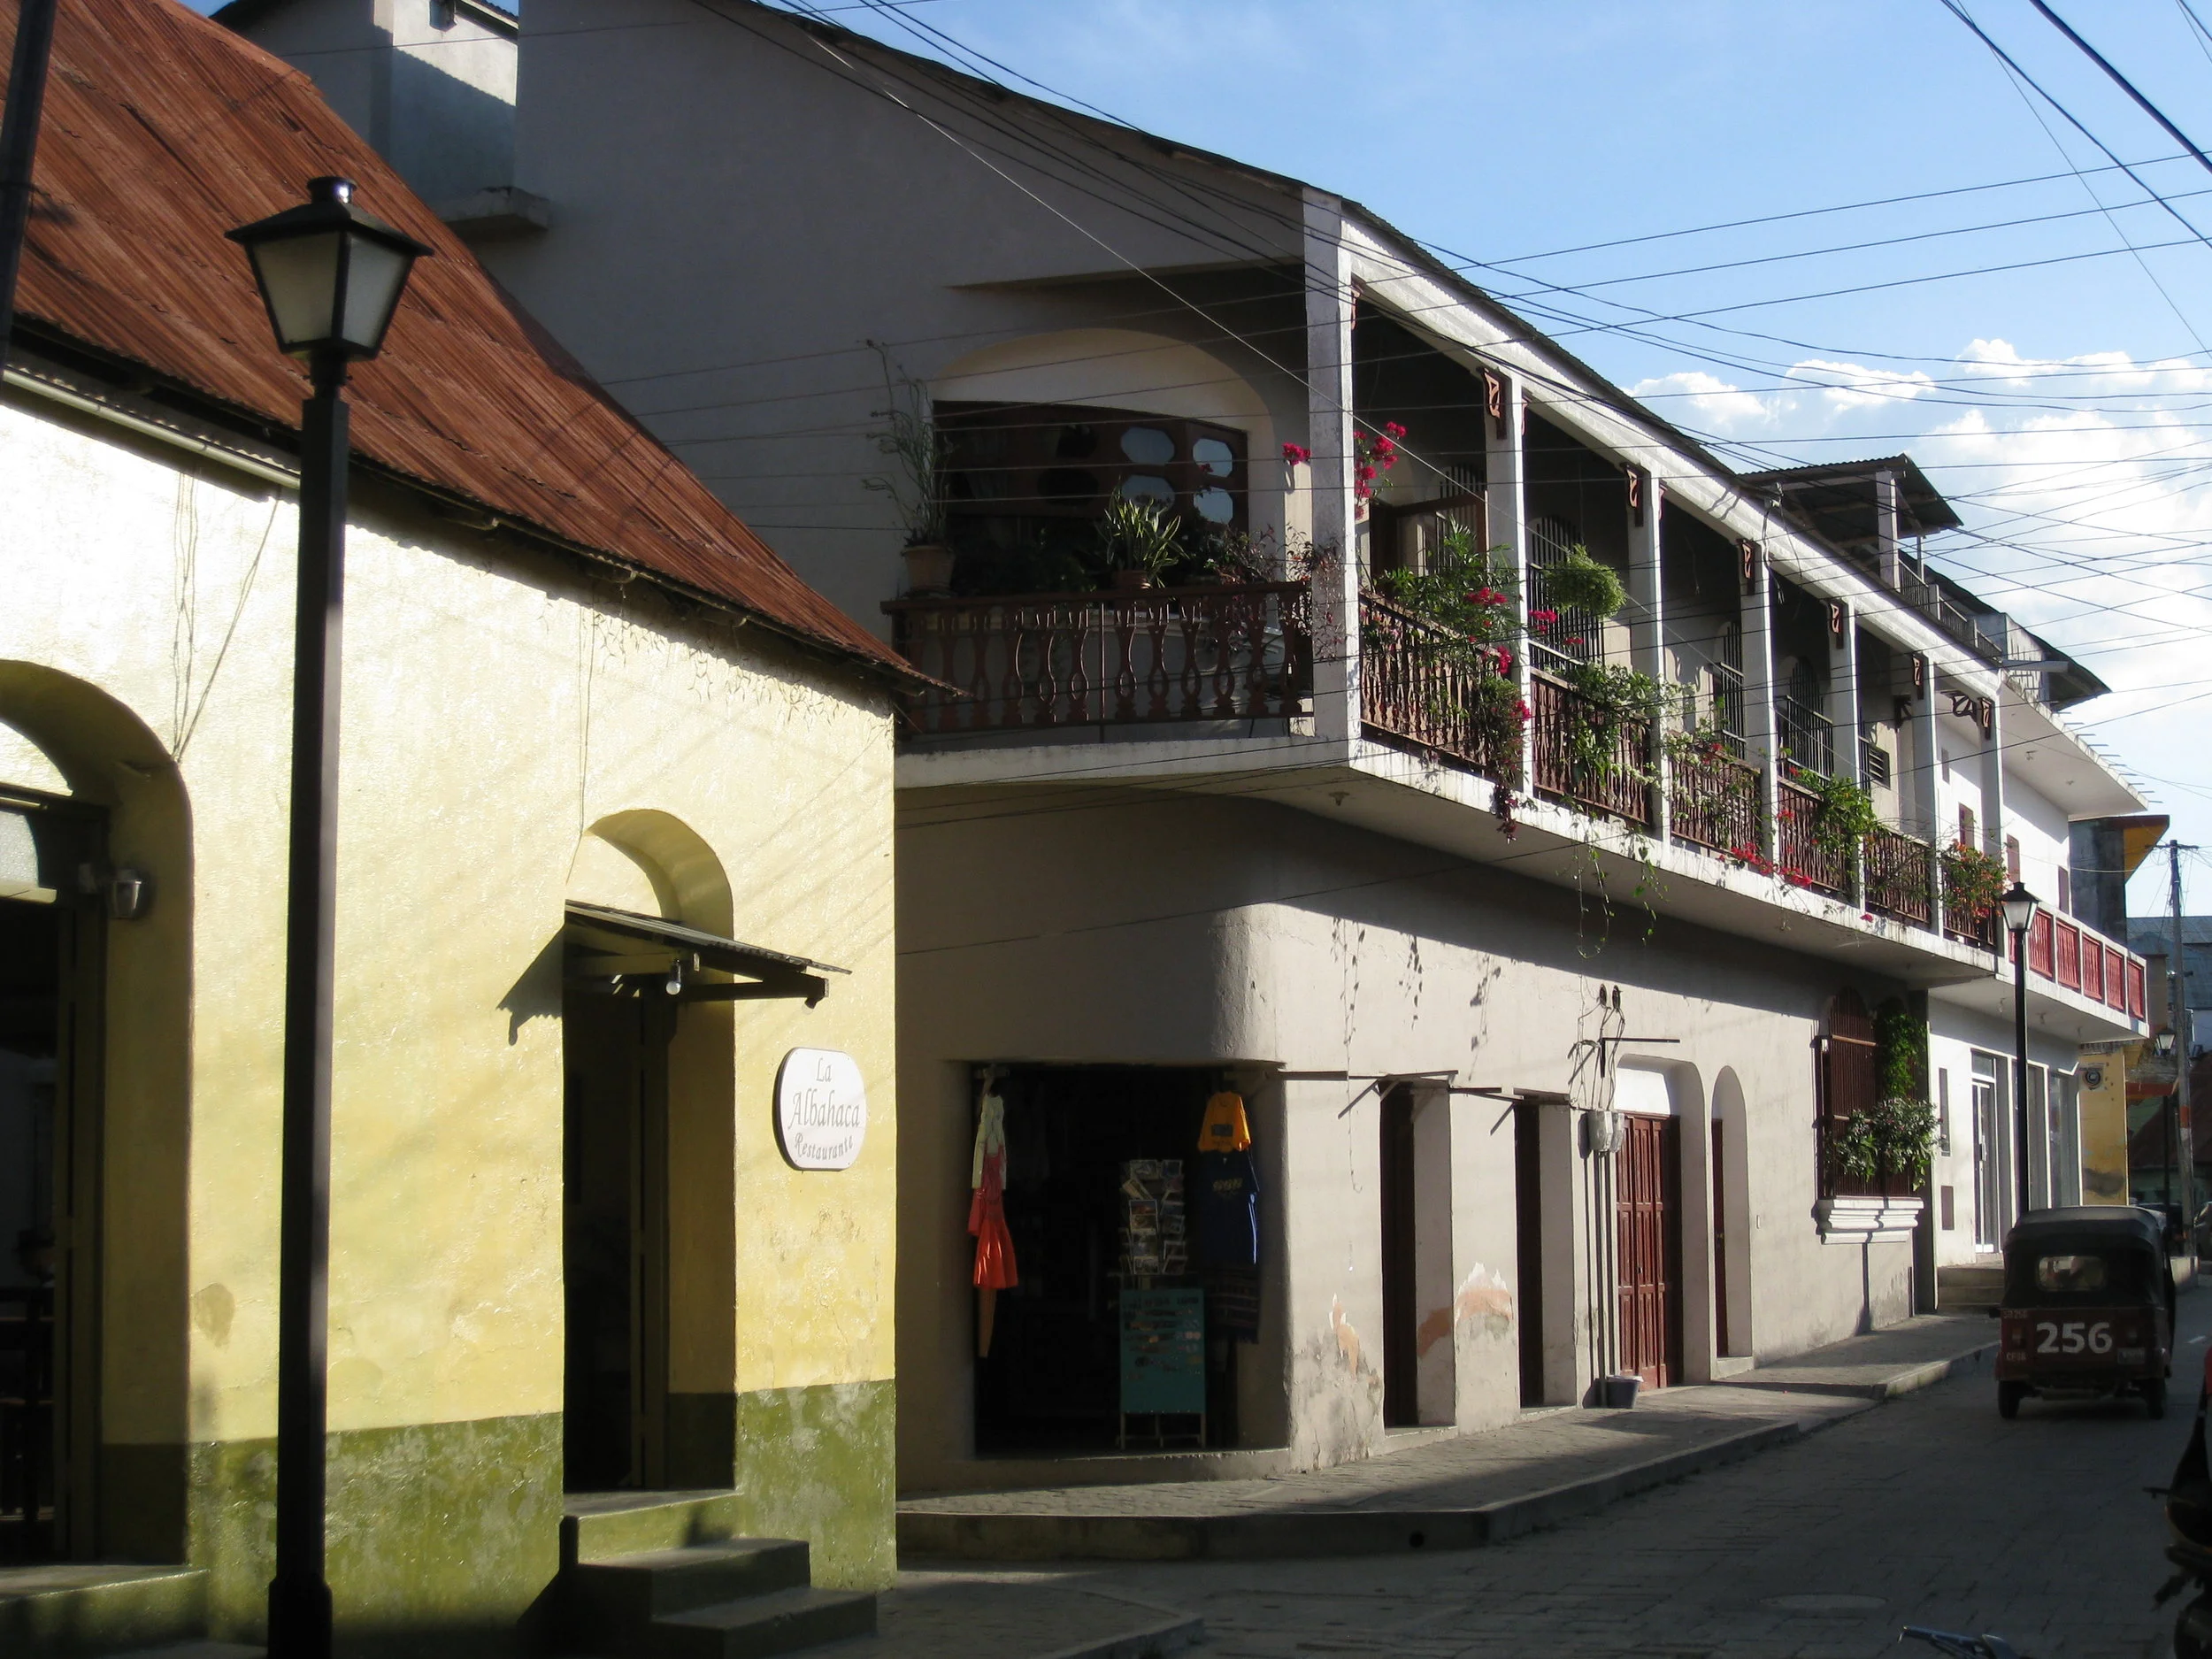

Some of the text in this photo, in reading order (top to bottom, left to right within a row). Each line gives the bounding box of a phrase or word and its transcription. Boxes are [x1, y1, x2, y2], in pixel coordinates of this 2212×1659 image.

[816, 1057, 832, 1082] La
[787, 1088, 860, 1130] Albahaca
[795, 1133, 853, 1160] Restaurante
[2036, 1322, 2113, 1354] 256
